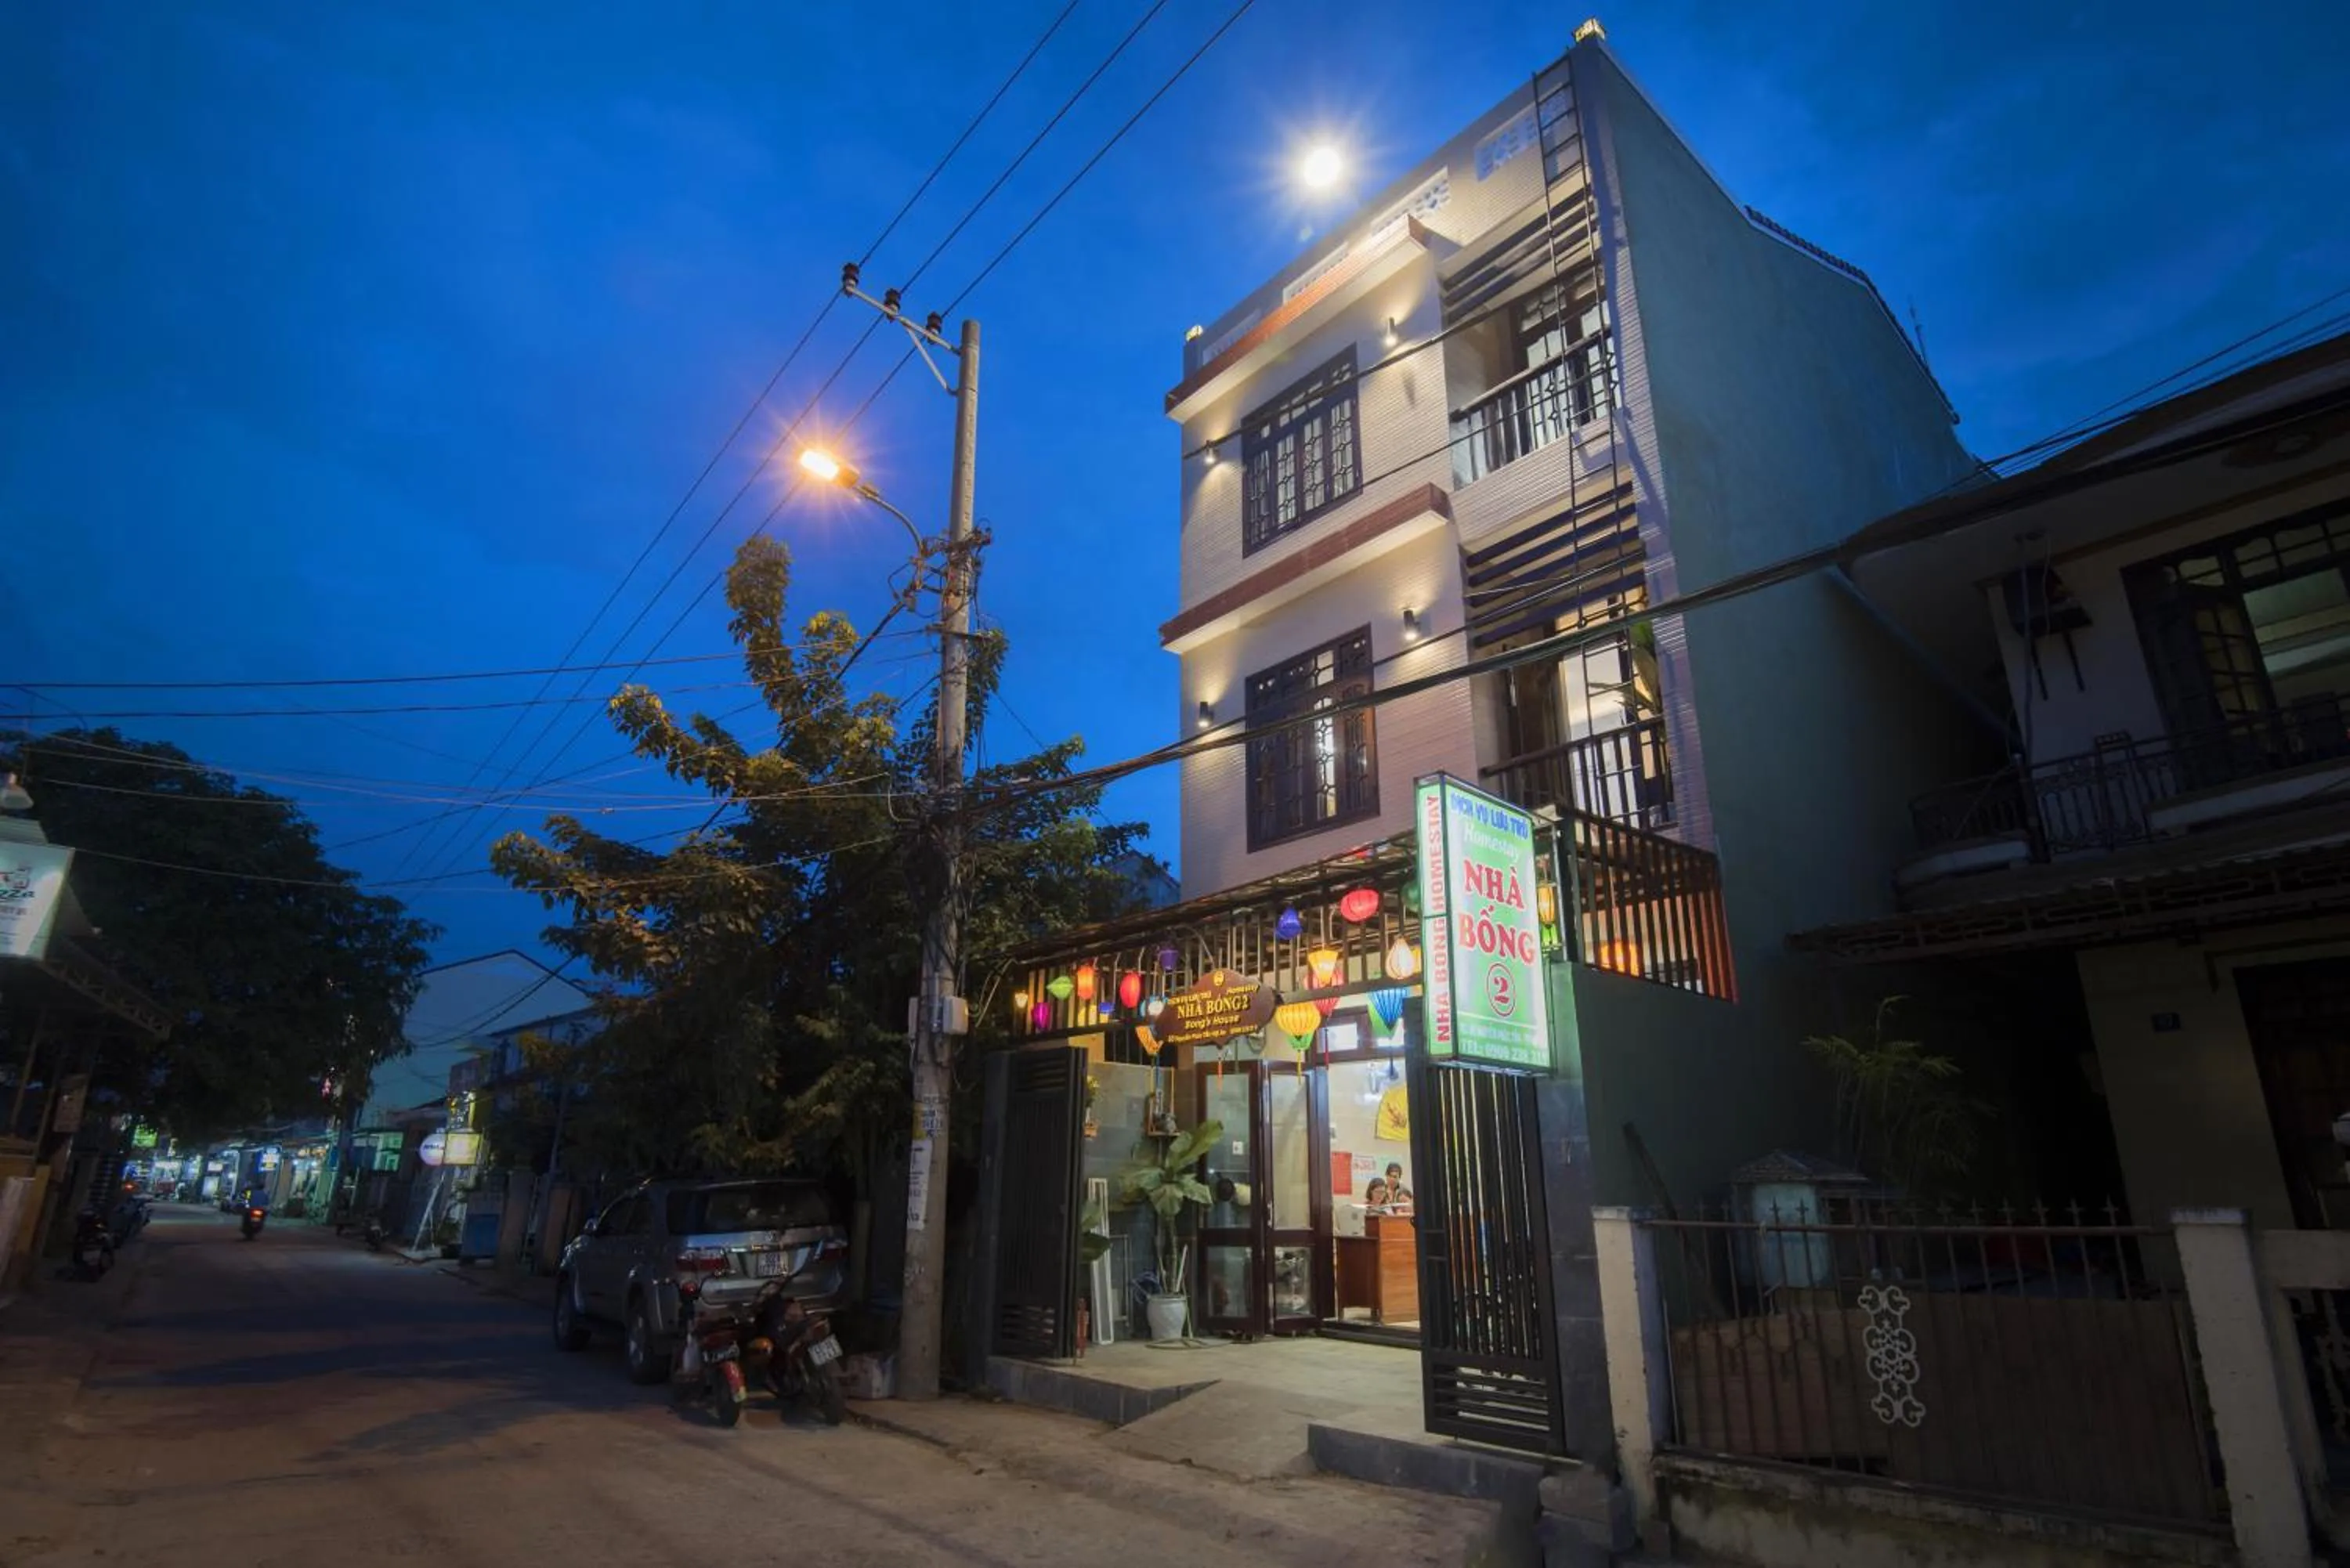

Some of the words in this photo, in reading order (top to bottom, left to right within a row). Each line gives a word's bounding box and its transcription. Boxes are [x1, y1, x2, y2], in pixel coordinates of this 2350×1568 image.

[1427, 795, 1447, 913] HOMESTAY
[1462, 858, 1525, 910] NHÀ
[1432, 916, 1449, 983] BONG
[1458, 905, 1536, 966] BỐNG
[1434, 992, 1451, 1042] NHA
[1493, 976, 1511, 1004] 2
